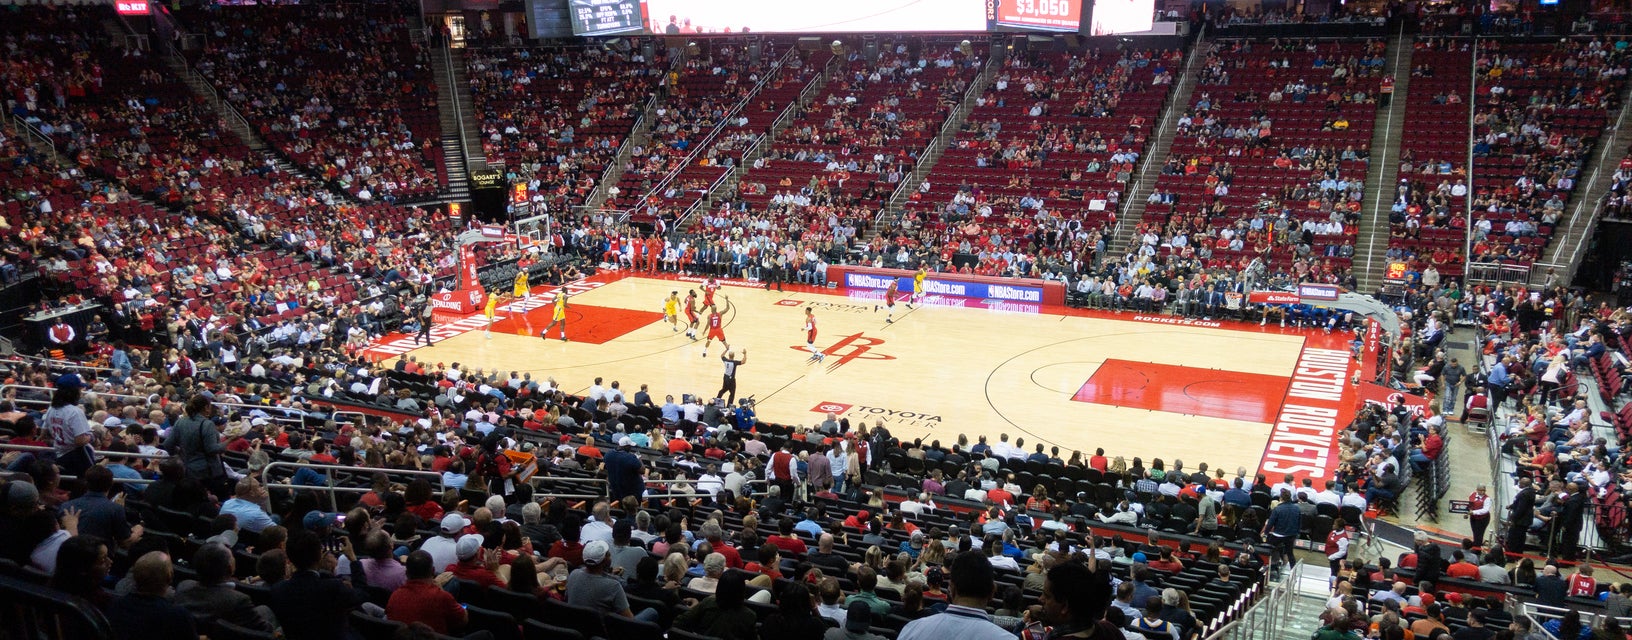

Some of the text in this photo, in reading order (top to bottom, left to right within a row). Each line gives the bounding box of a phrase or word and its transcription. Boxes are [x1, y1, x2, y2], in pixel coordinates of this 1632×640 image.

[1016, 0, 1069, 17] $3,050
[515, 190, 527, 202] 24
[1389, 270, 1402, 279] 24
[995, 284, 1040, 302] NBAStore.com
[432, 299, 462, 312] SPALDING
[1133, 315, 1221, 328] ROCKETS.COM
[1369, 321, 1378, 352] NBA TV
[858, 405, 942, 423] TOYOTA
[1263, 347, 1351, 478] HOUSTON ROCKETS
